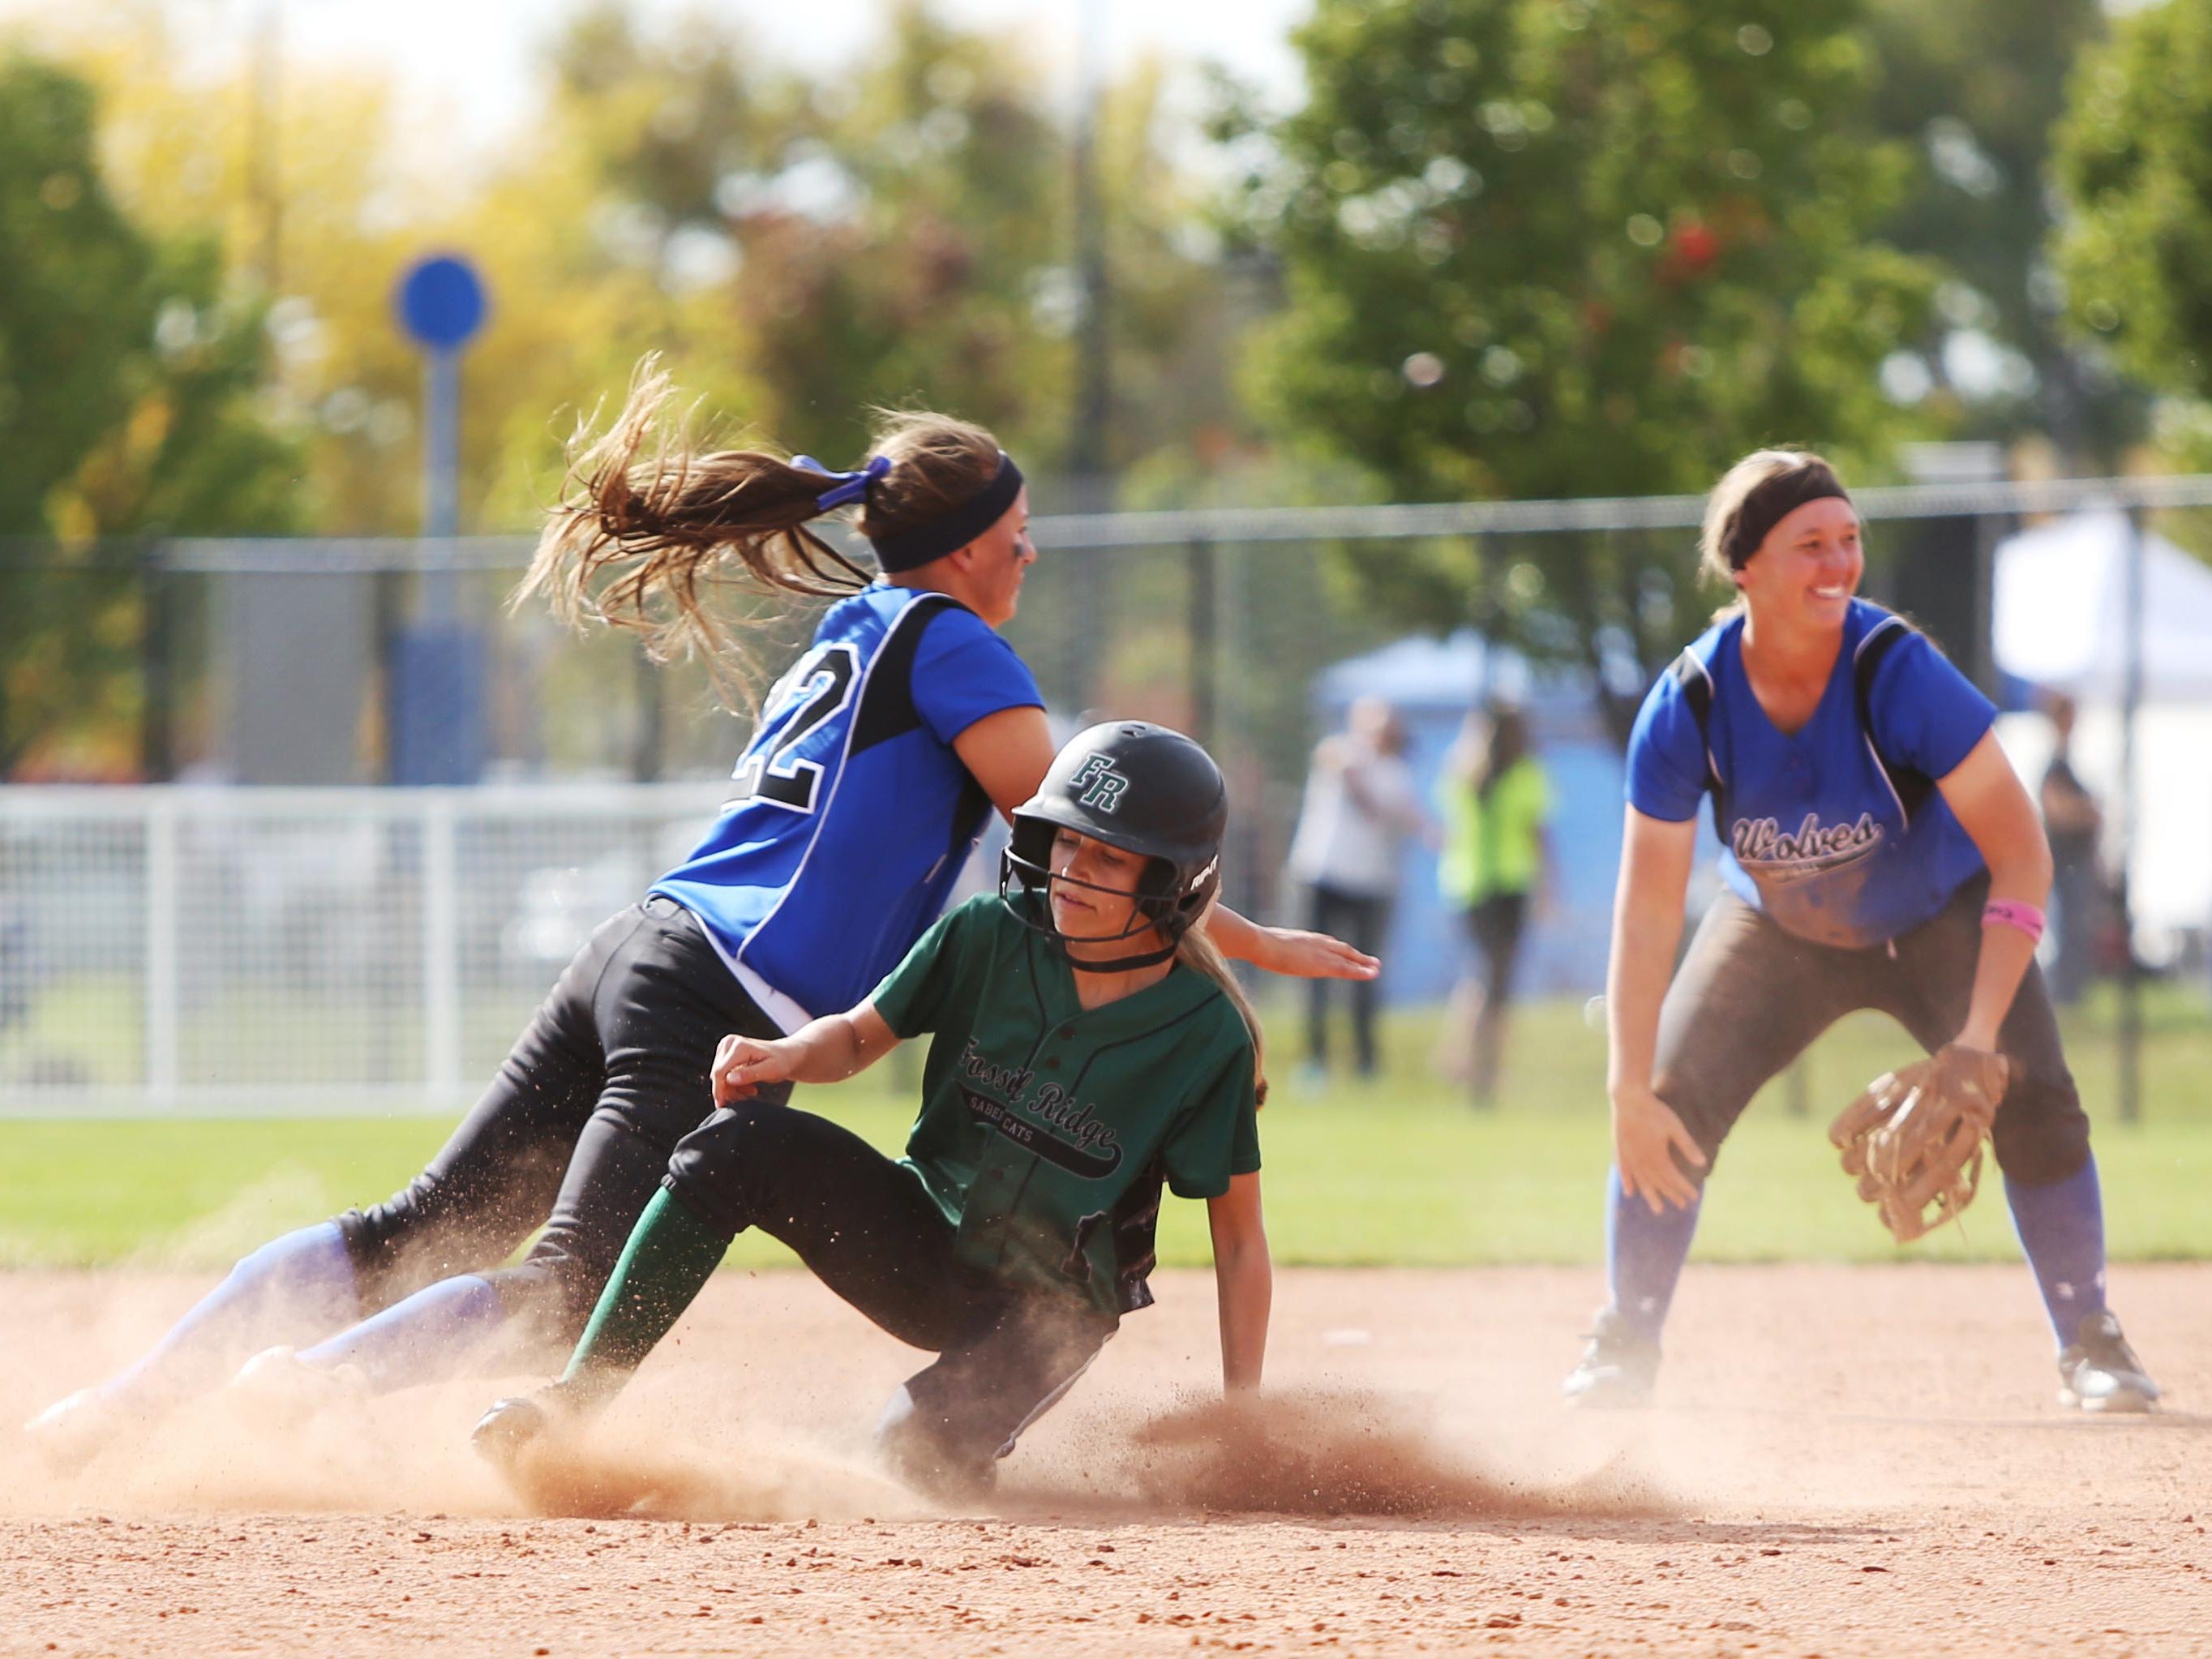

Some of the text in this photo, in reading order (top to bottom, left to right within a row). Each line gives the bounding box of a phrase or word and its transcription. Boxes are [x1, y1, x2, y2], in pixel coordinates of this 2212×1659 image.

[1070, 752, 1128, 812] FR
[1732, 812, 1885, 862] Wolves
[1027, 1082, 1117, 1150] Ridge
